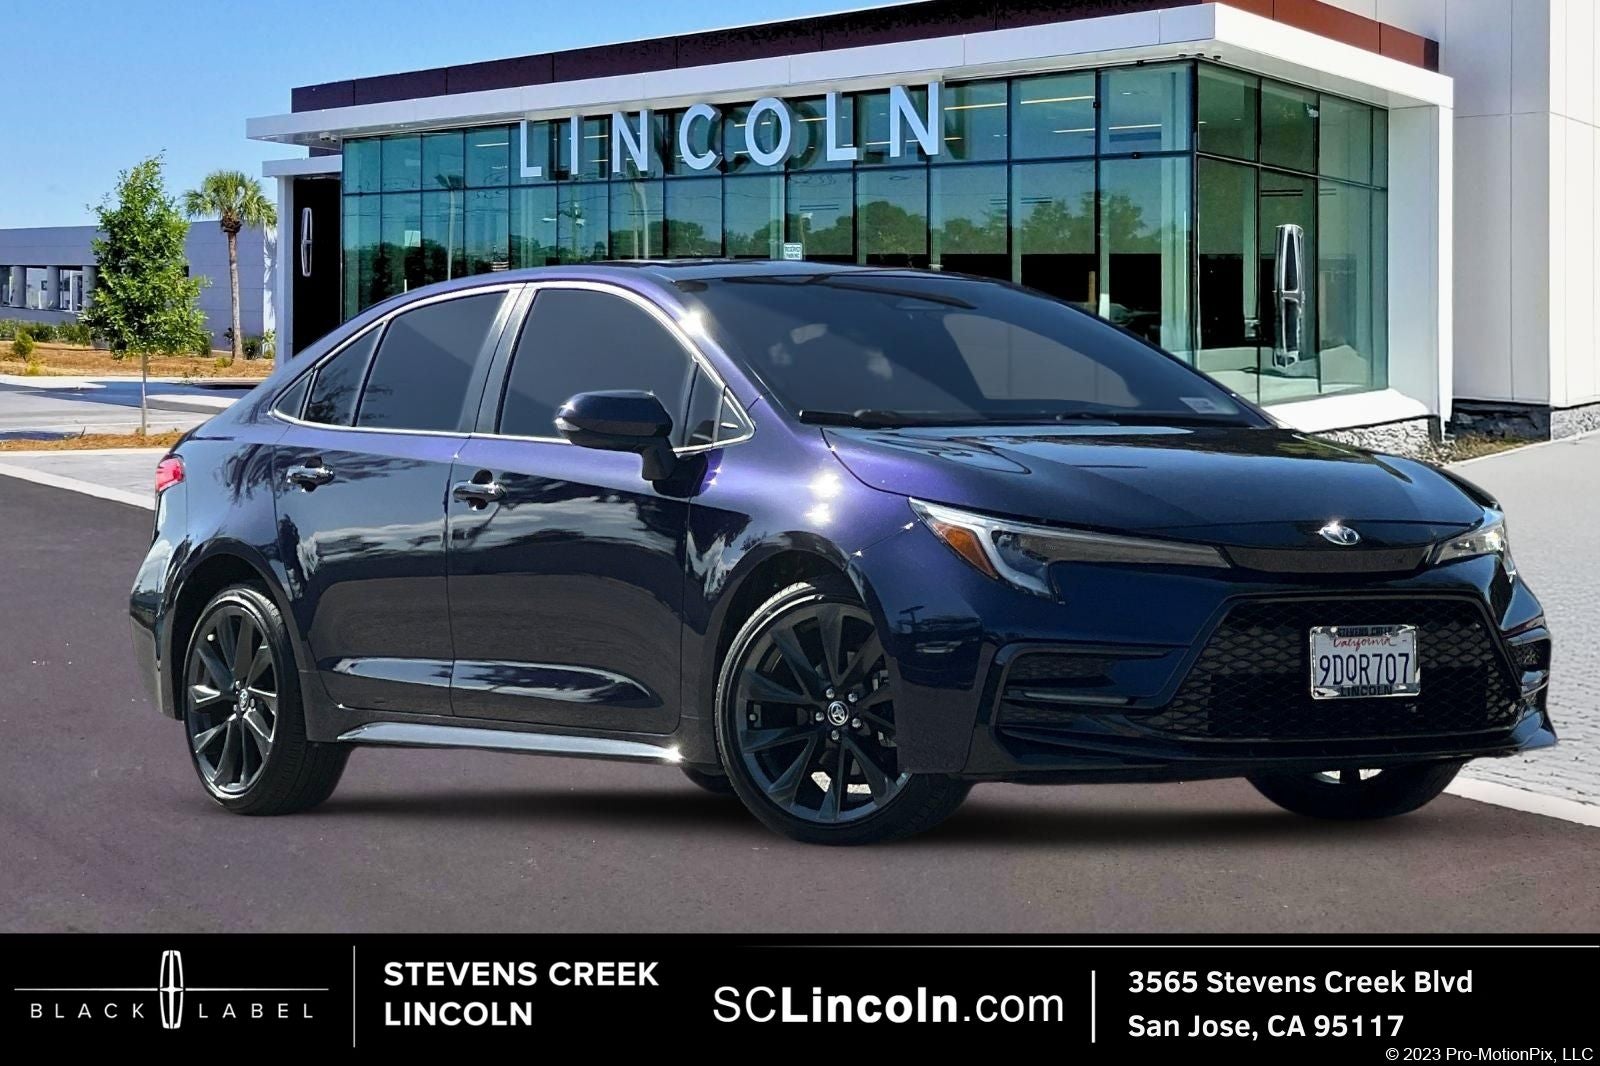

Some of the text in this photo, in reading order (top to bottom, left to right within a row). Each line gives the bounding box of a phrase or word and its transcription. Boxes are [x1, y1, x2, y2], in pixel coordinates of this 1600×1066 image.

[520, 82, 943, 178] LINCOLN
[1333, 635, 1397, 651] California
[1319, 653, 1410, 686] 9DQR707
[1340, 684, 1393, 696] LINCOLN
